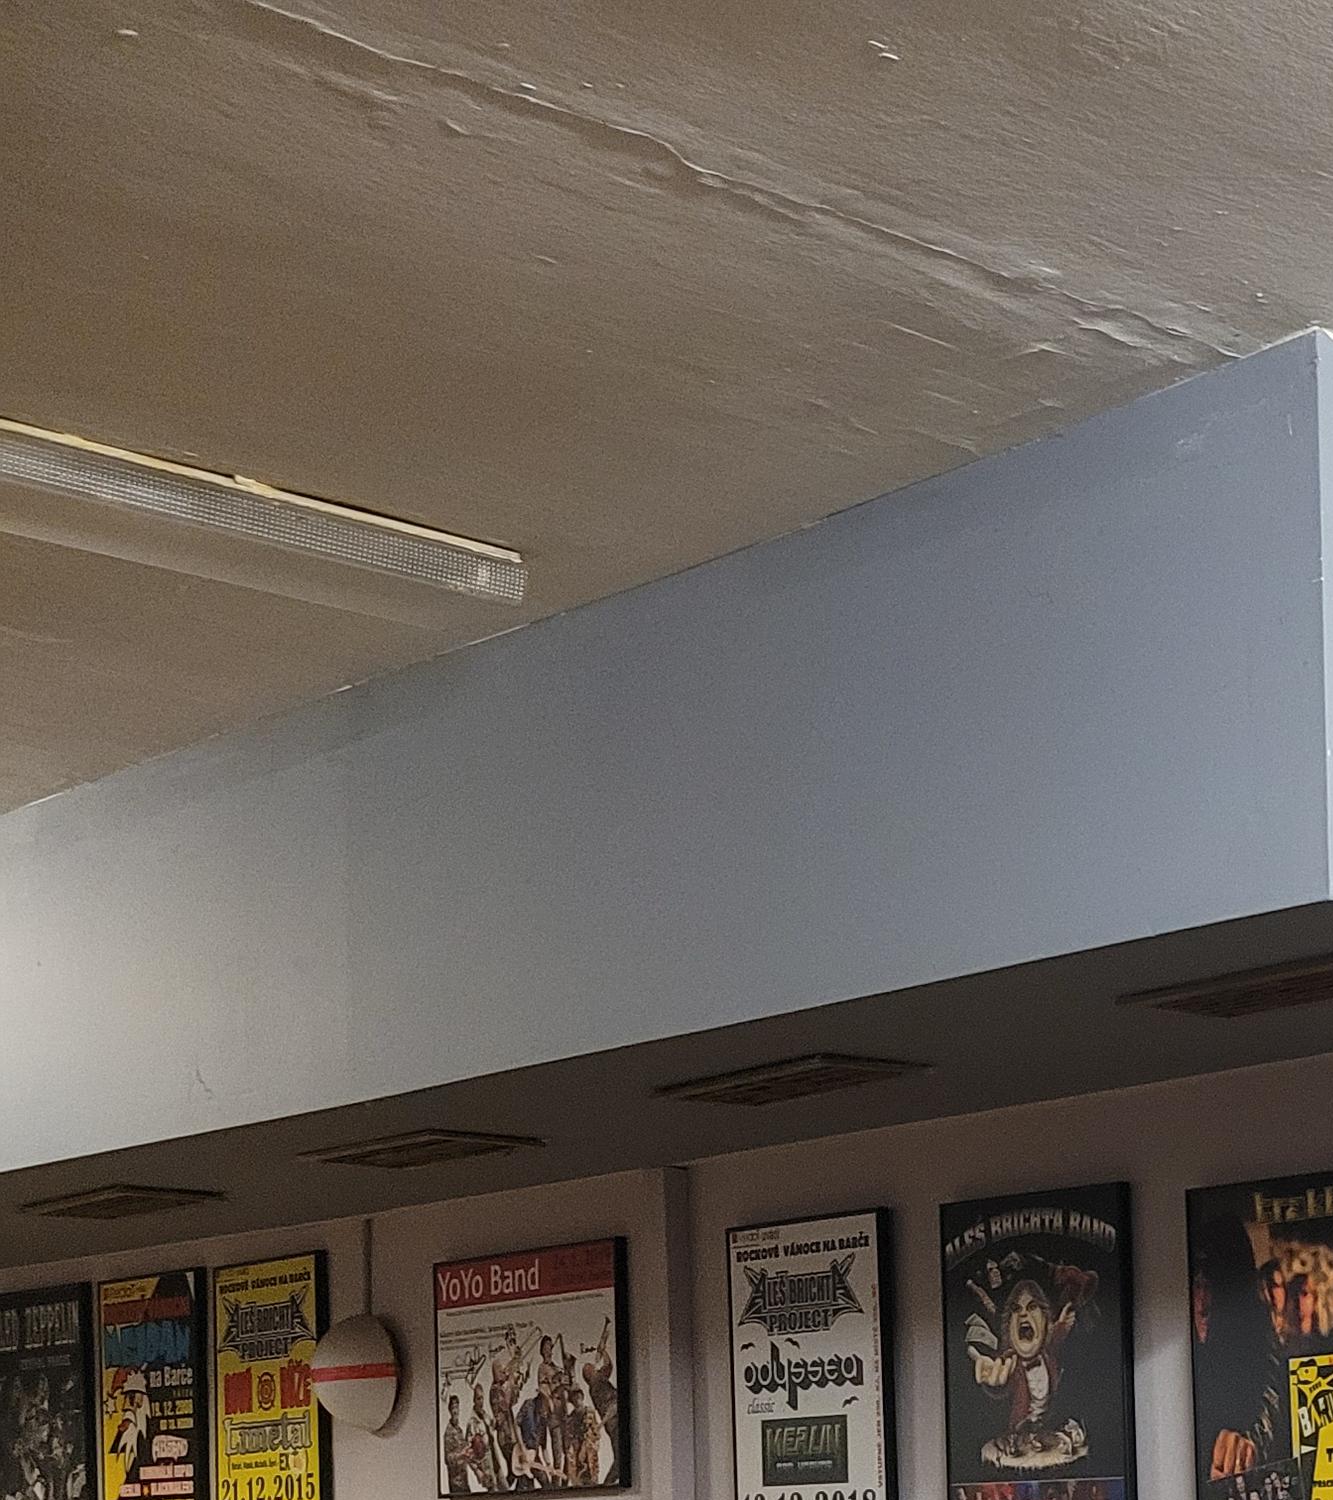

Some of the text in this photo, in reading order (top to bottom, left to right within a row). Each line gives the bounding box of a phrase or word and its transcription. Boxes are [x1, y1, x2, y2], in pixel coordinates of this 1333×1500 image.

[438, 1259, 540, 1302] YoYo Band
[768, 1308, 832, 1333] PROJECT
